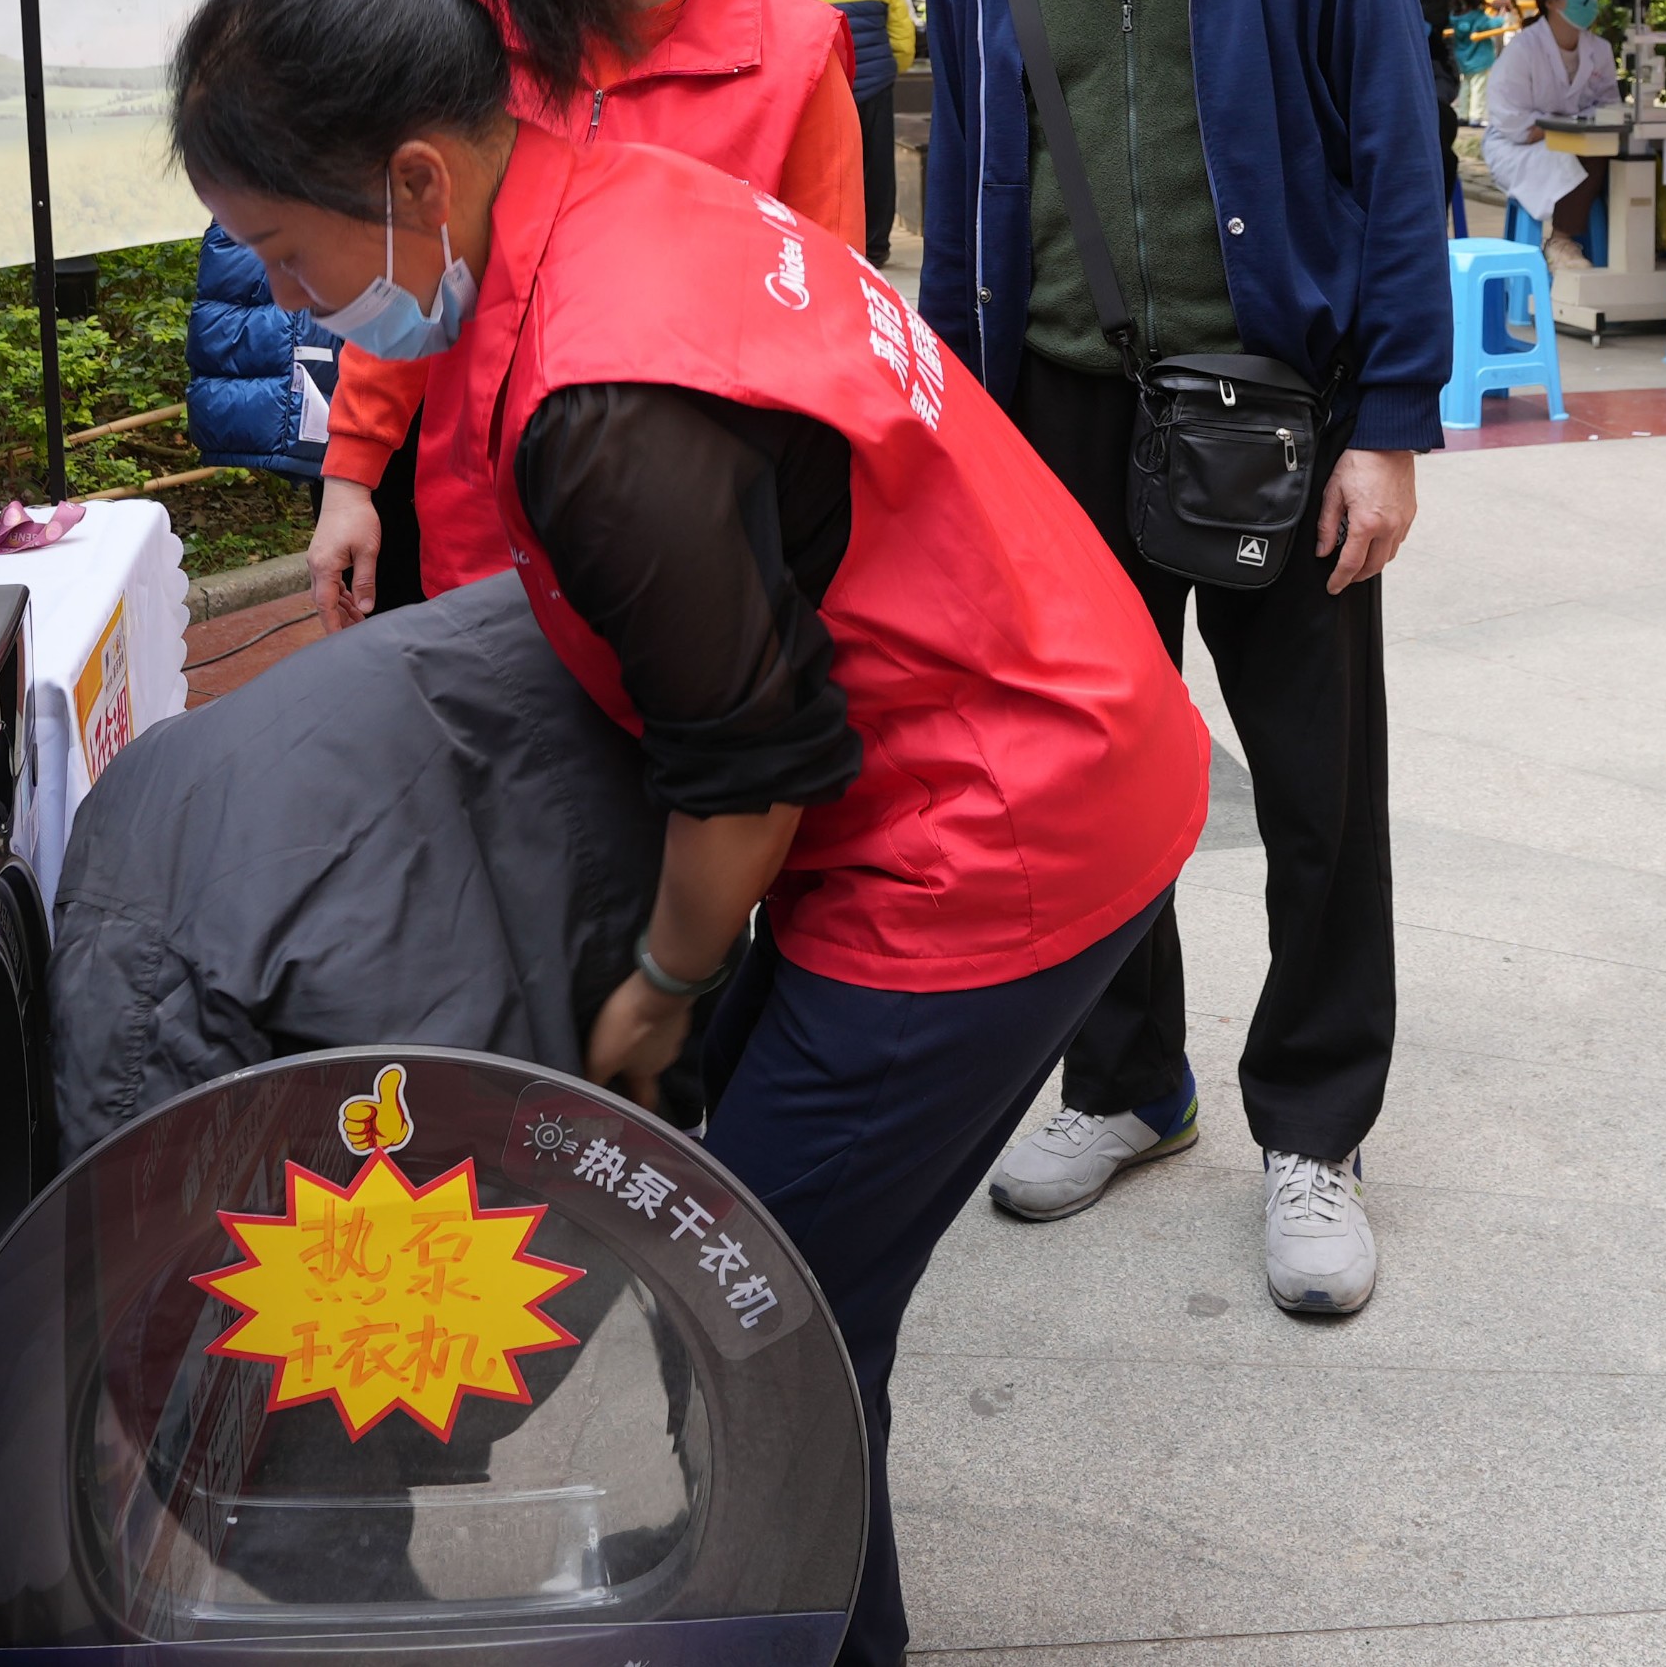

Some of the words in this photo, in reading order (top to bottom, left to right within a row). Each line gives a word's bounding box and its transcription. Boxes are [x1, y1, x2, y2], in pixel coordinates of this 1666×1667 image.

[296, 1198, 481, 1307] 热泵
[574, 1137, 784, 1330] 热泵干衣机
[288, 1314, 498, 1394] 干衣机
